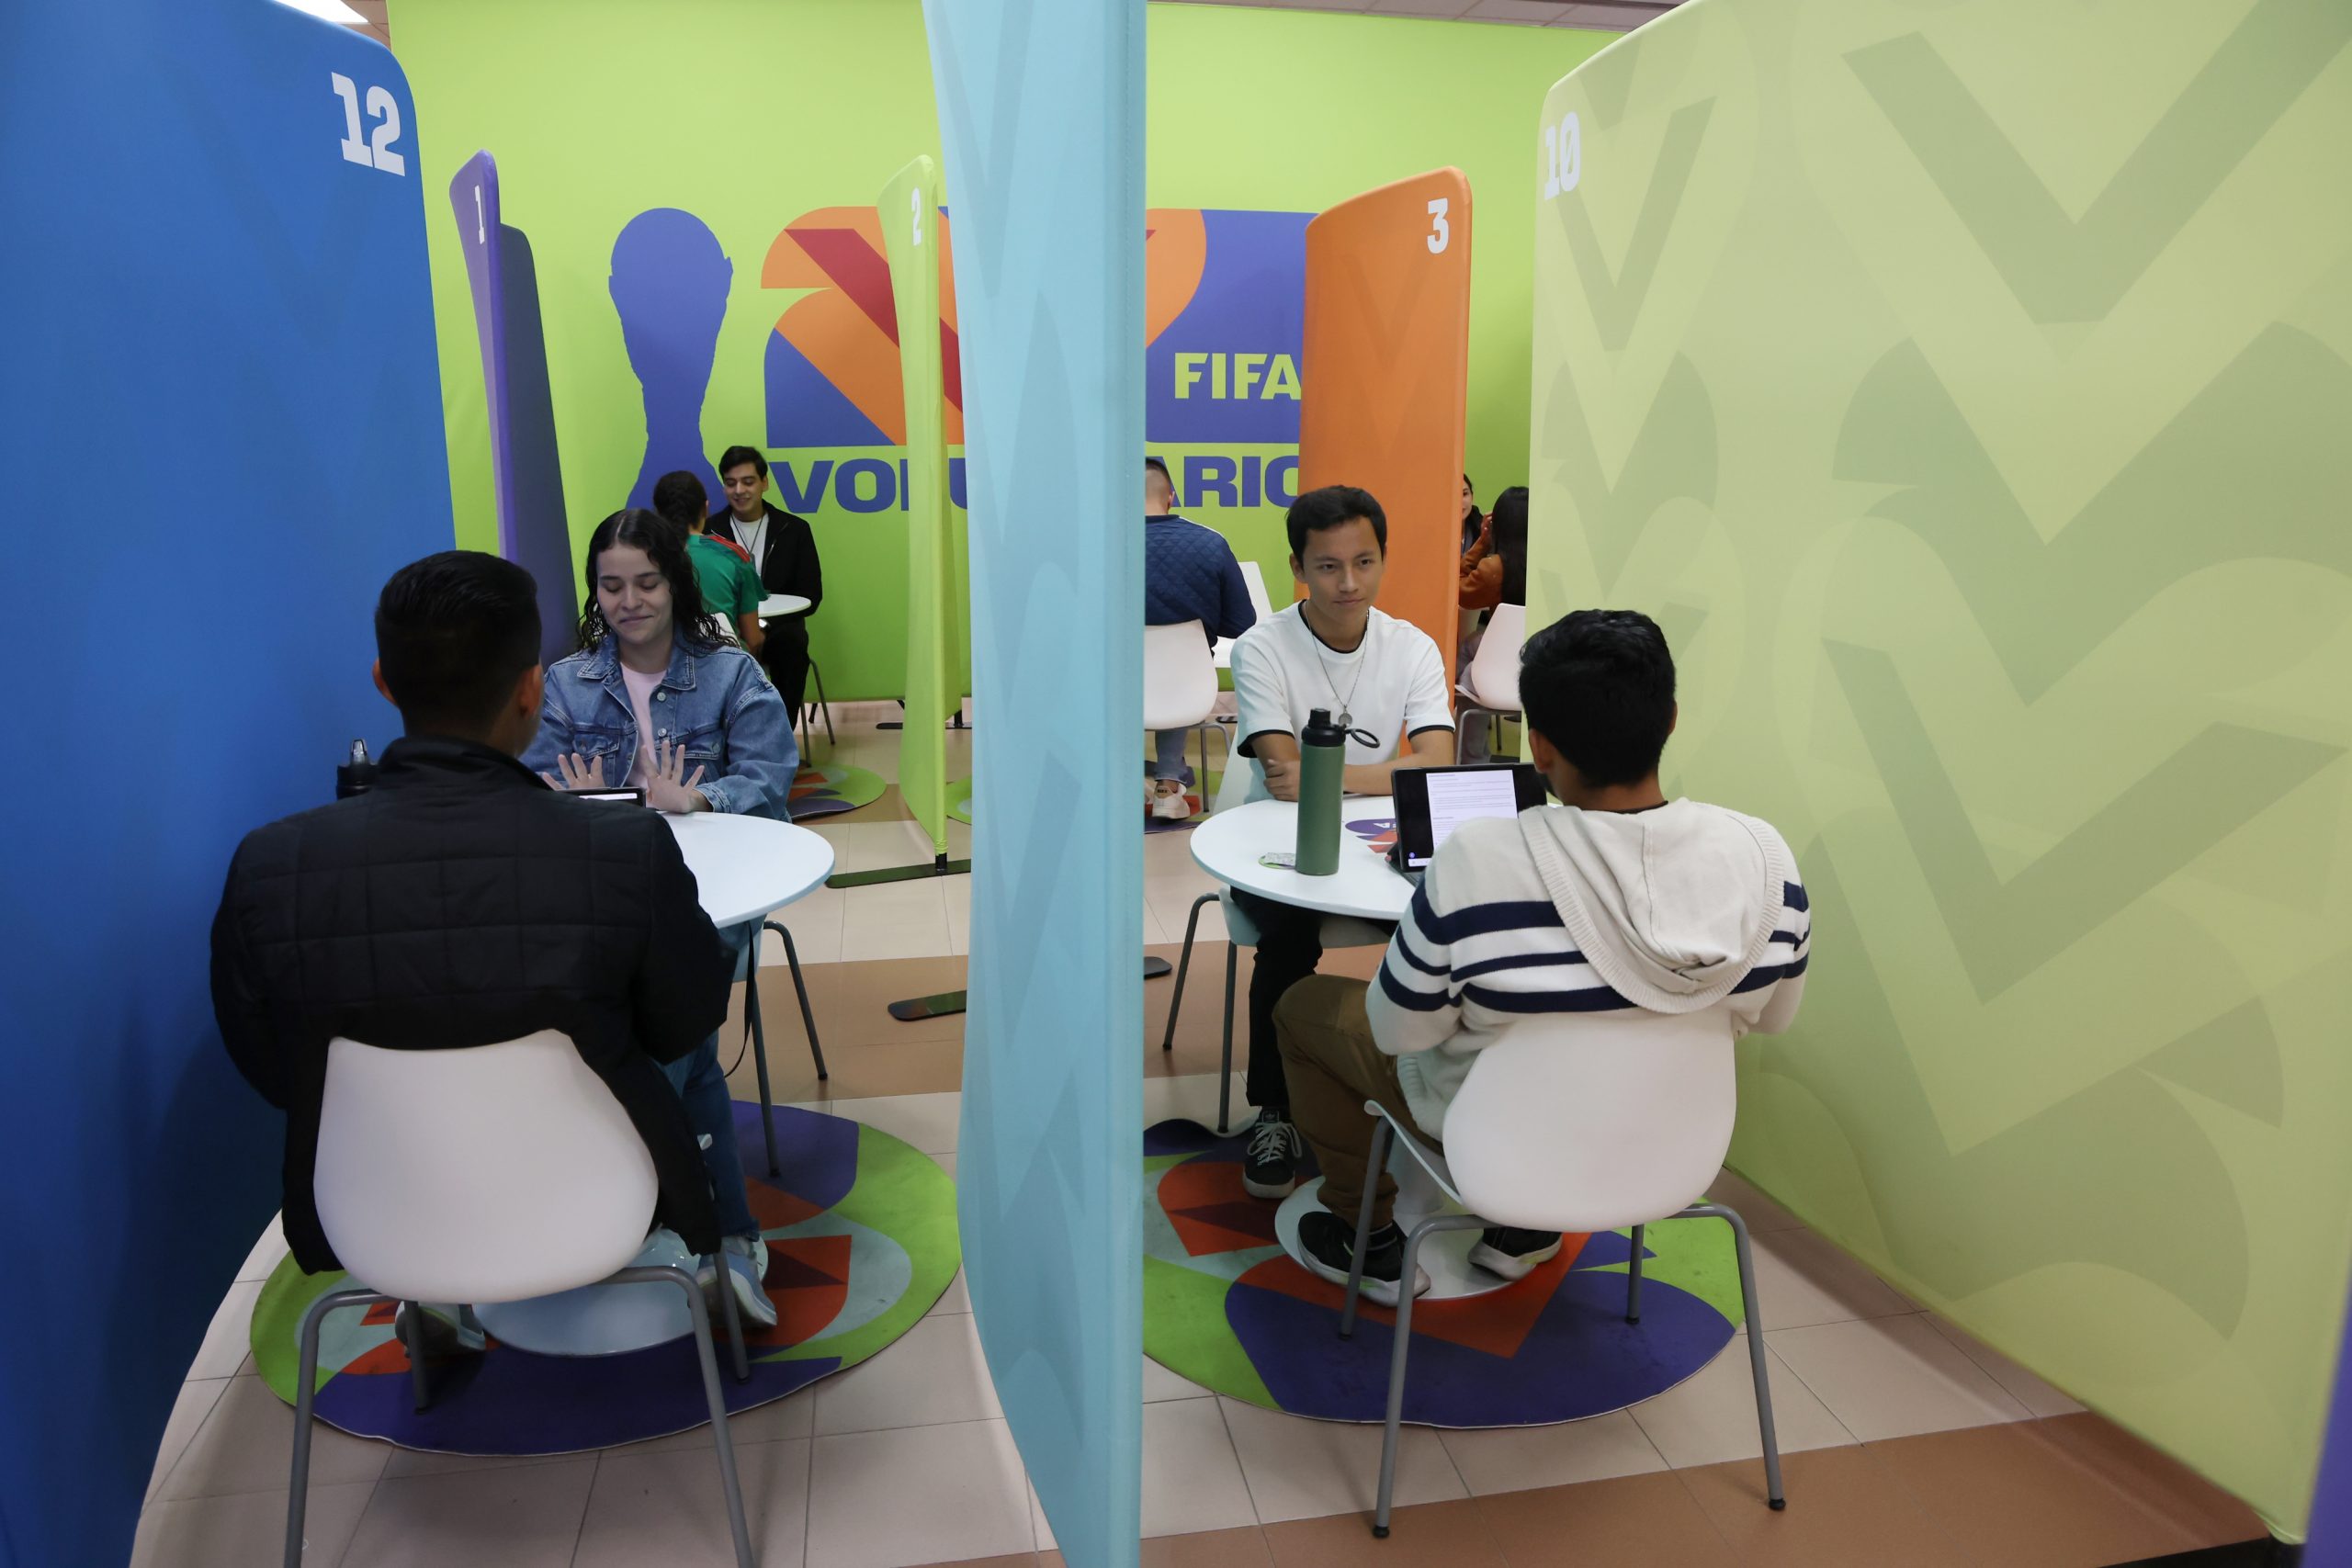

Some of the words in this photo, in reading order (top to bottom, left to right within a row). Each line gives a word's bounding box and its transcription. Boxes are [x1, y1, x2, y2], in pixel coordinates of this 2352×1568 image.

[331, 72, 406, 177] 12
[1544, 111, 1580, 200] 10
[474, 185, 485, 245] 1
[911, 186, 922, 247] 2
[1427, 197, 1449, 254] 3
[1174, 352, 1302, 400] FIFA
